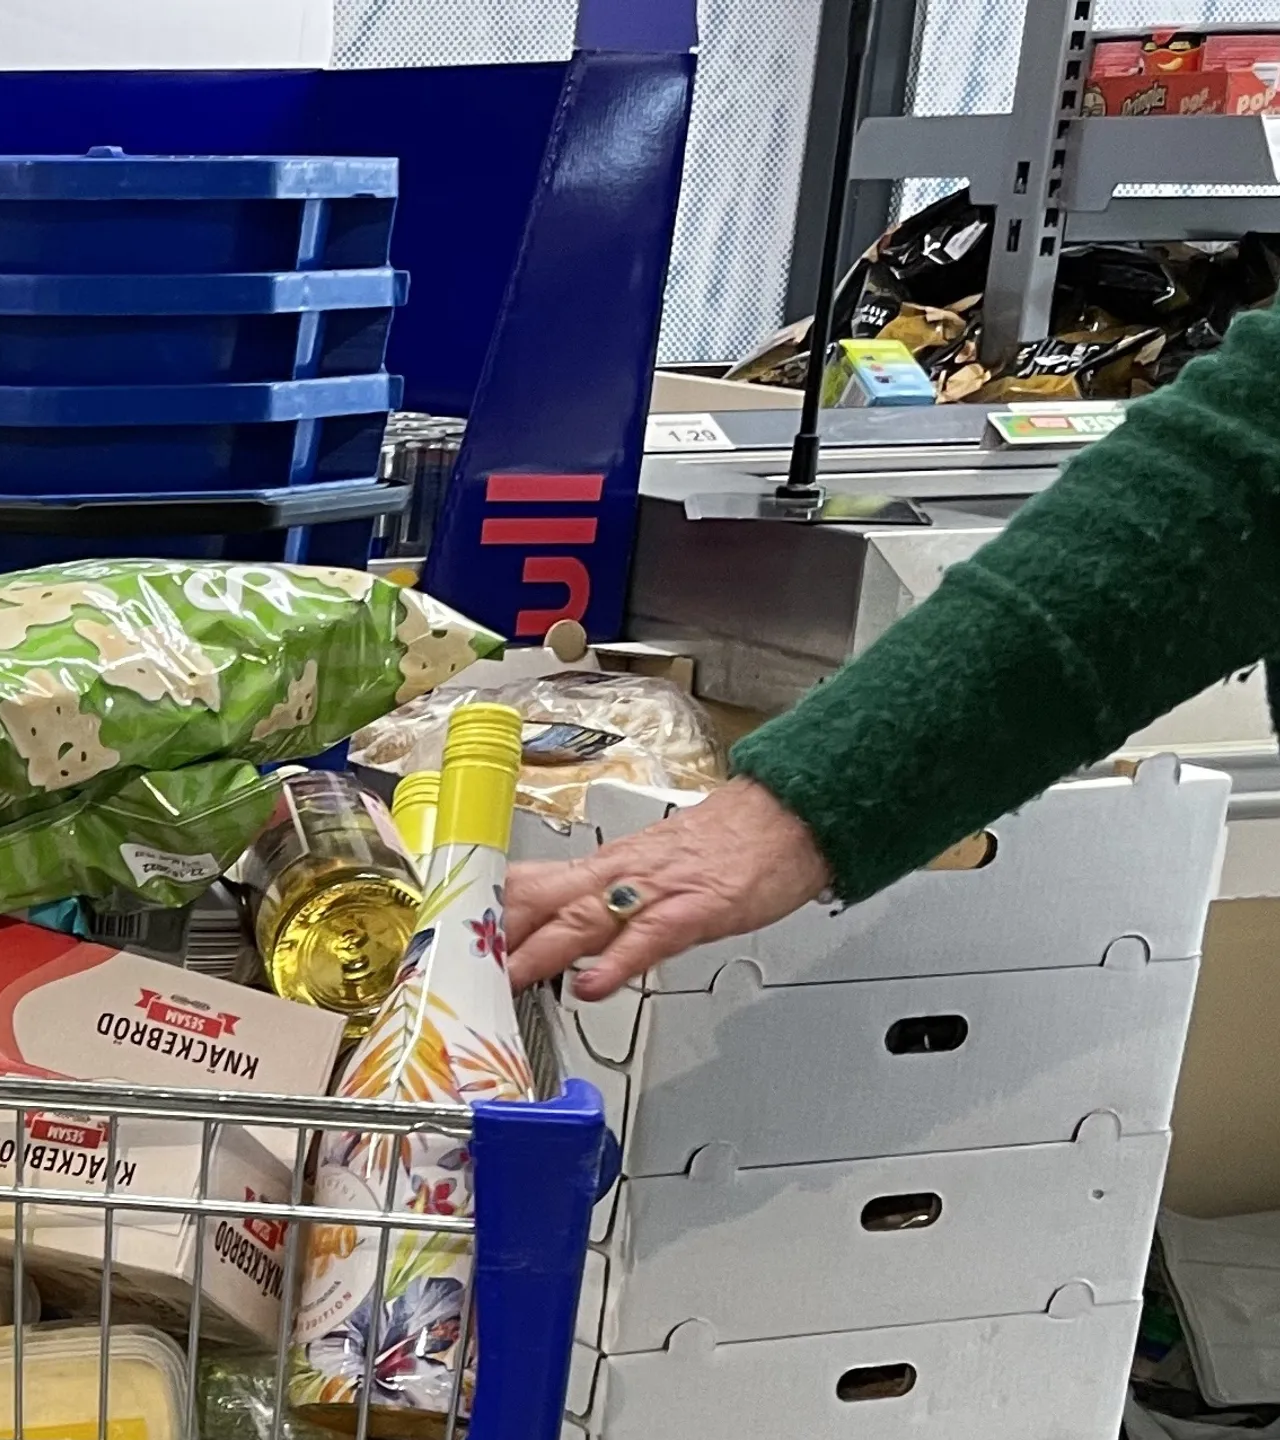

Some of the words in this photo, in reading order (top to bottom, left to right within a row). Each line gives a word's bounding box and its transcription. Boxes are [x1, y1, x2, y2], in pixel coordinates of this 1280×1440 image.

[668, 429, 718, 443] 1.29
[164, 1008, 207, 1032] SESAM
[96, 1012, 260, 1080] KNÄCKEBRÖD
[46, 1125, 87, 1145] SESAM
[214, 1220, 284, 1302] NÄCKEBRÖD
